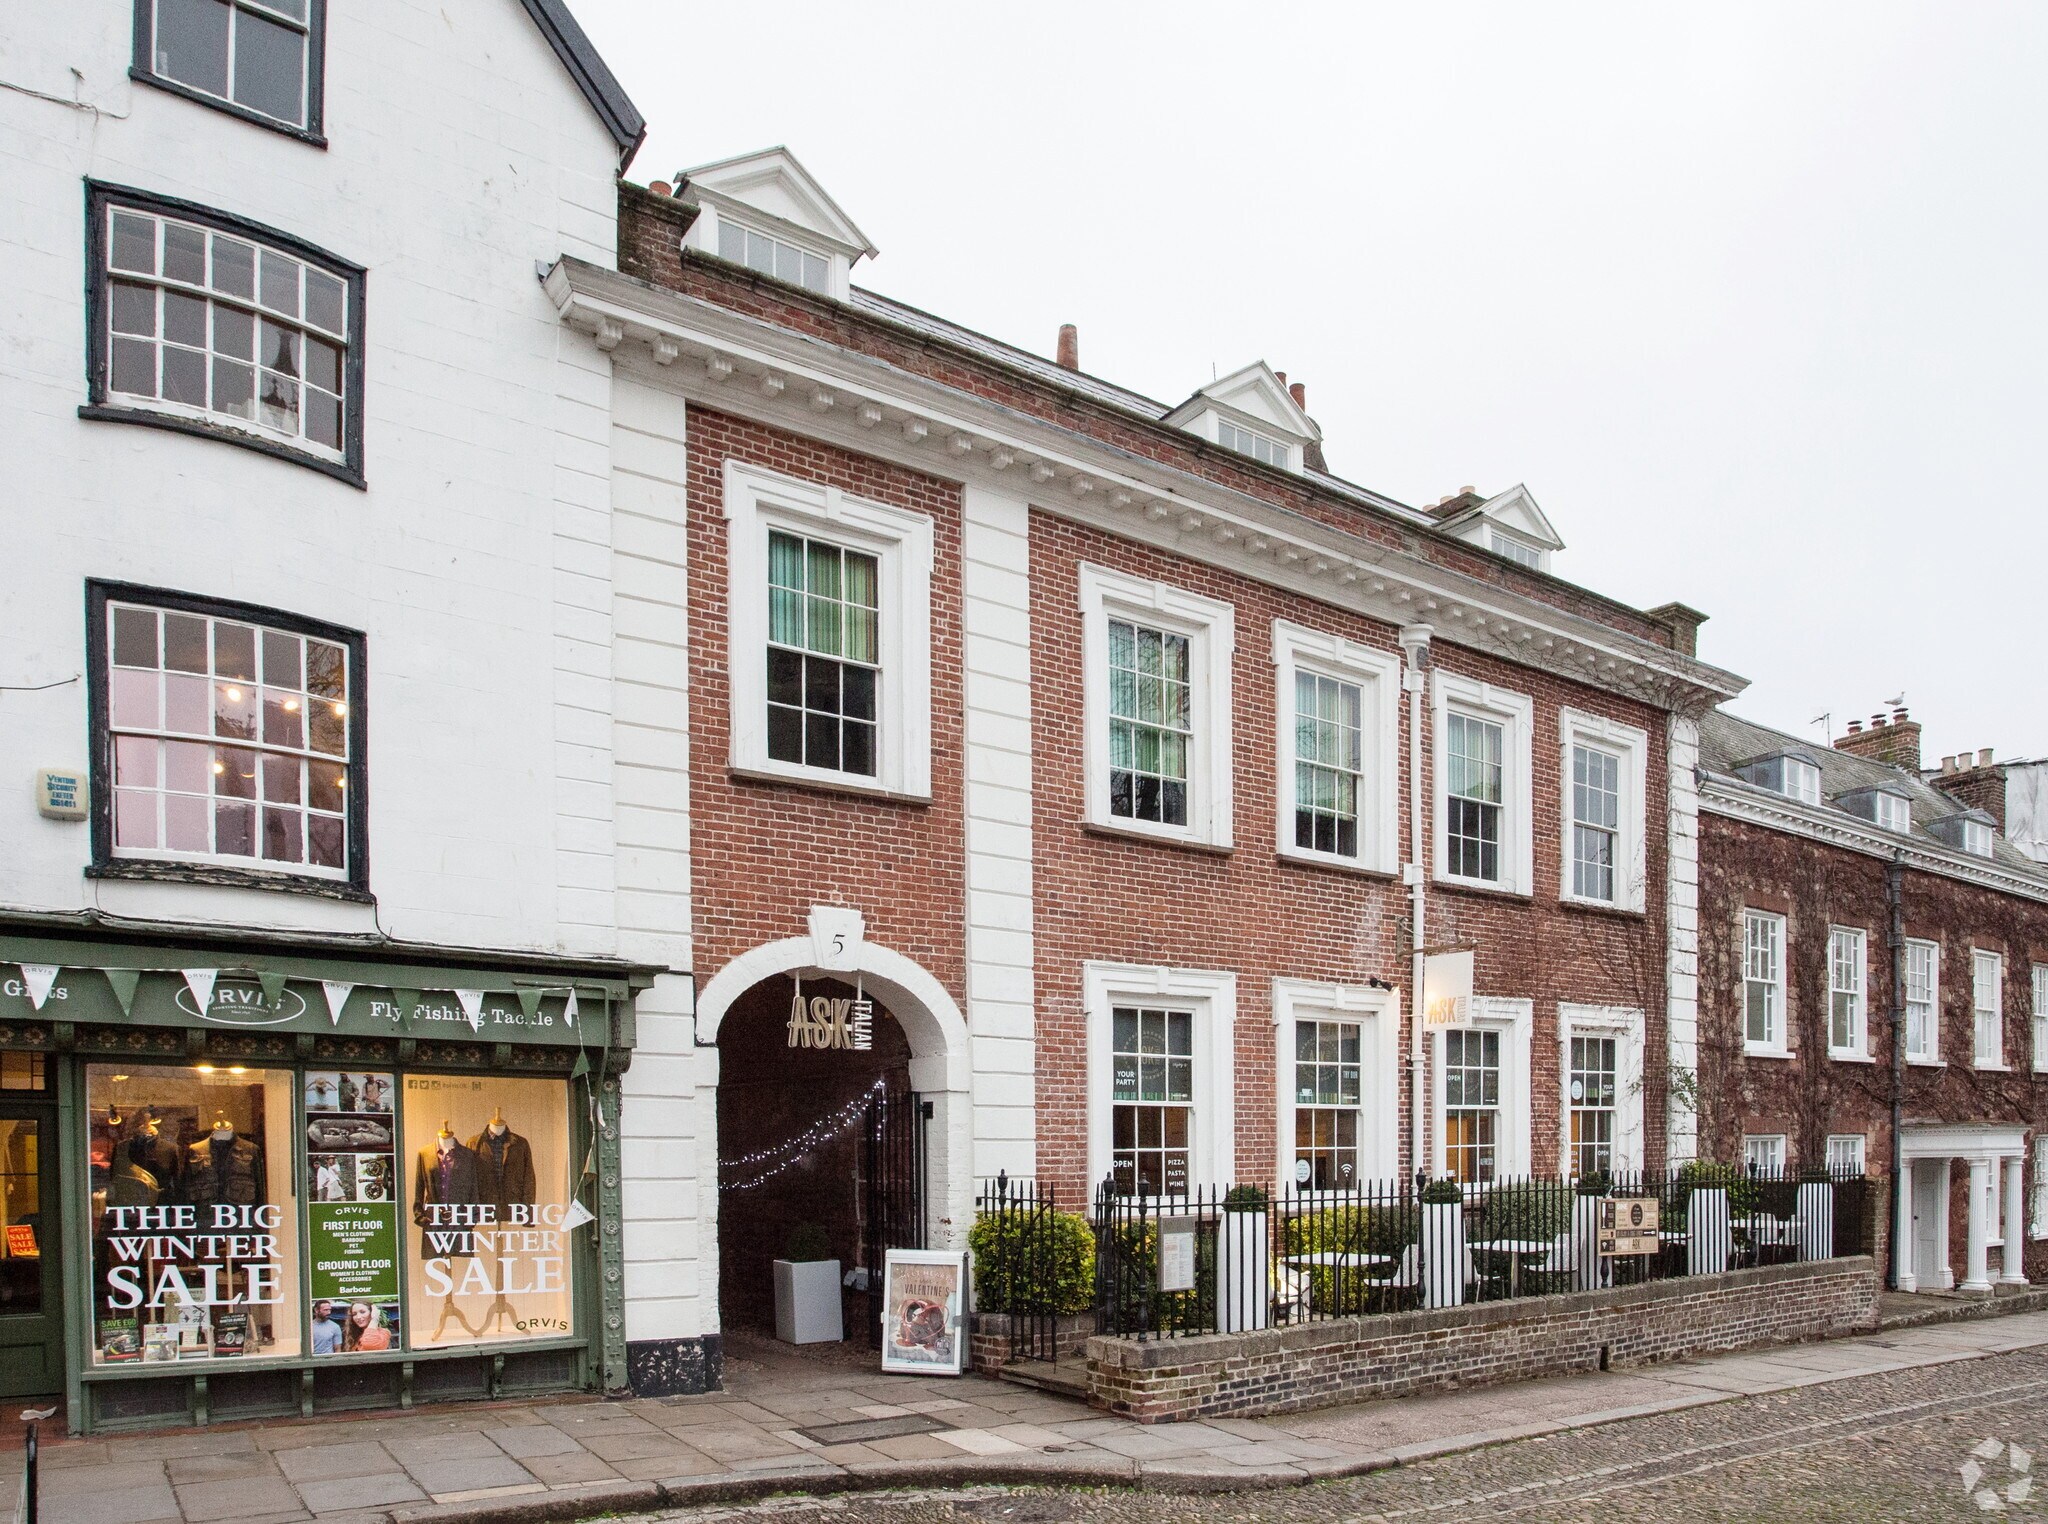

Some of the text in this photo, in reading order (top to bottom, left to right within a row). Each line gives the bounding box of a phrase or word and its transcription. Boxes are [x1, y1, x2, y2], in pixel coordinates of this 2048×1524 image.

[832, 934, 845, 955] 5
[24, 967, 53, 976] ORVIS
[324, 982, 349, 991] ORVIS
[370, 1001, 402, 1022] Fly
[1428, 997, 1456, 1024] ASK
[787, 996, 851, 1049] ASK
[854, 1000, 872, 1050] ITALIAN
[1117, 1070, 1135, 1078] YOUR
[106, 1204, 283, 1230] THE BIG
[335, 1207, 370, 1215] ORVIS
[424, 1203, 565, 1226] THE BIG
[323, 1220, 383, 1231] FIRST FLOOR
[107, 1234, 283, 1261] WINTER
[425, 1231, 565, 1254] WINTER
[317, 1259, 391, 1271] GROUND FLOOR
[107, 1263, 285, 1309] SALE
[424, 1256, 566, 1297] SALE
[905, 1284, 950, 1297] VALENTINE'S
[101, 1320, 122, 1328] SAVE
[516, 1318, 568, 1331] ORVIS
